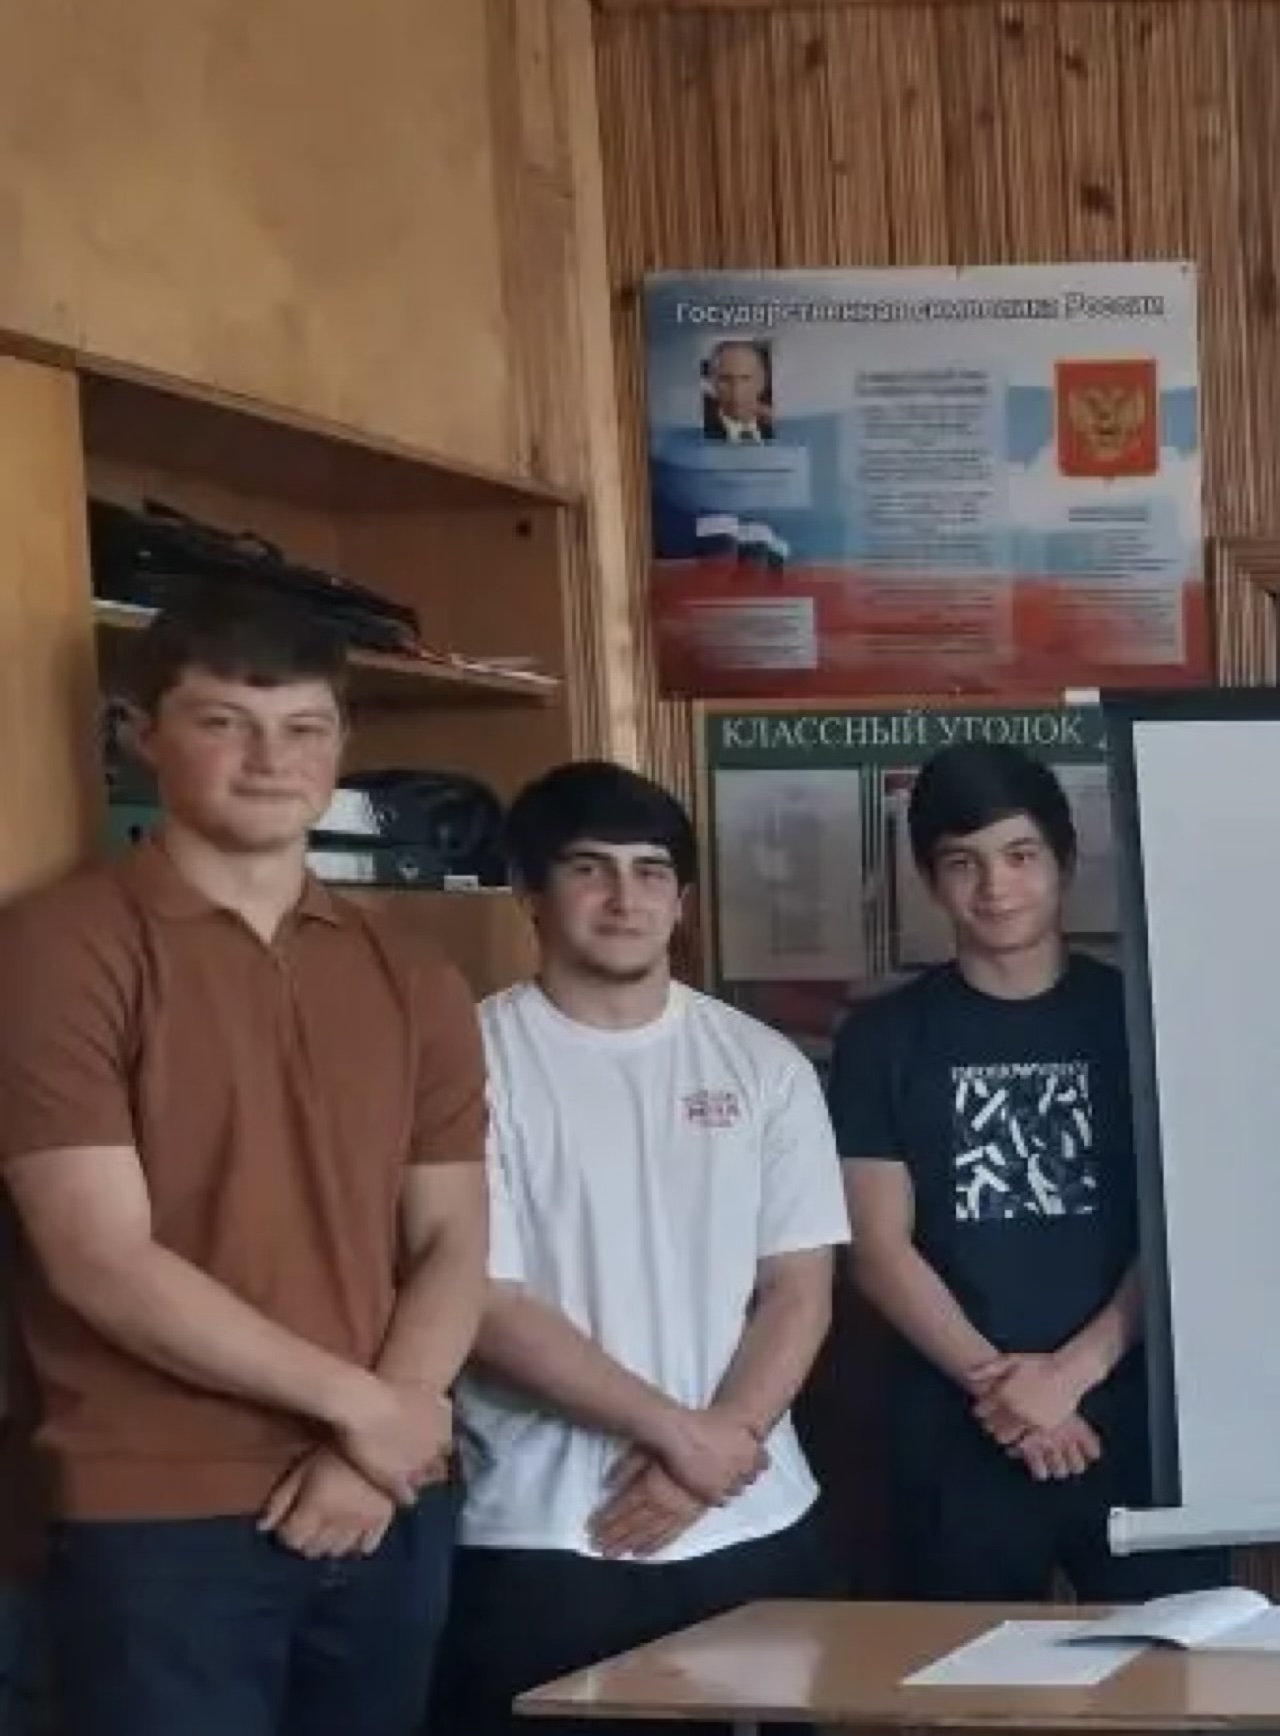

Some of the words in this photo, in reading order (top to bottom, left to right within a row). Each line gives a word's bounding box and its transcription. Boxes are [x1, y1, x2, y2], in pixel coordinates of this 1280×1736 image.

[675, 298, 907, 326] Государственная
[1064, 291, 1165, 319] России
[722, 708, 927, 749] КЛАССНЫЙ
[937, 714, 1084, 745] УГОЛОК
